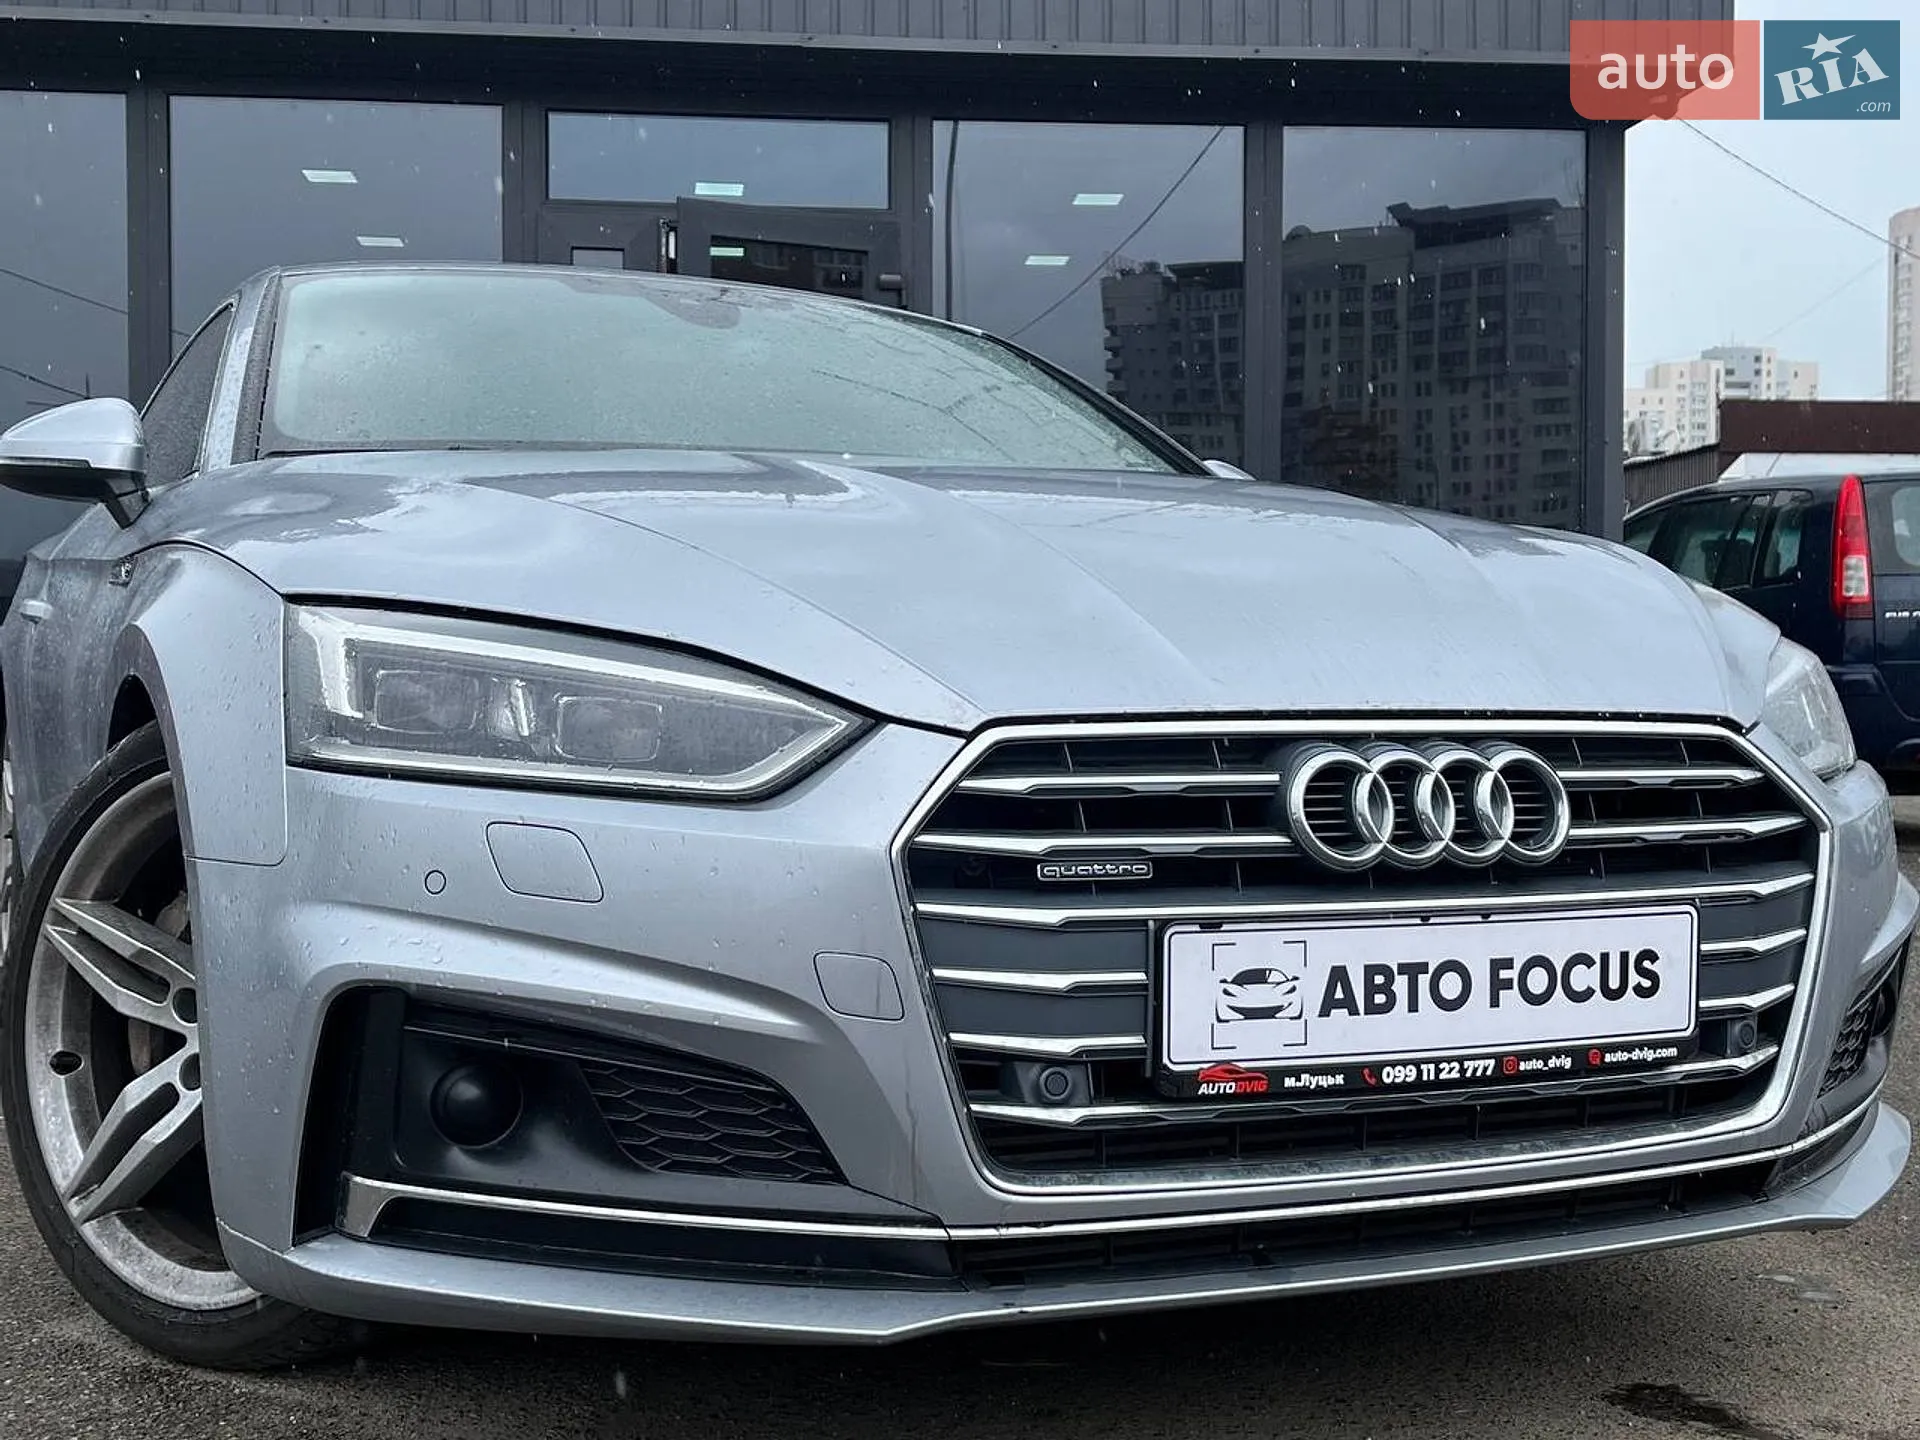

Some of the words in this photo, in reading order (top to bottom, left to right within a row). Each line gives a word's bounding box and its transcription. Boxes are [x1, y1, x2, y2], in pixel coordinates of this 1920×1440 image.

[1043, 863, 1148, 878] quattro
[1489, 948, 1660, 1009] FOCUS
[1604, 1046, 1678, 1062] auto-dvig.com
[1519, 1055, 1572, 1070] auto_dvig
[1381, 1065, 1417, 1083] 099
[1421, 1063, 1436, 1080] 11
[1439, 1061, 1460, 1079] 22
[1464, 1059, 1496, 1077] 777
